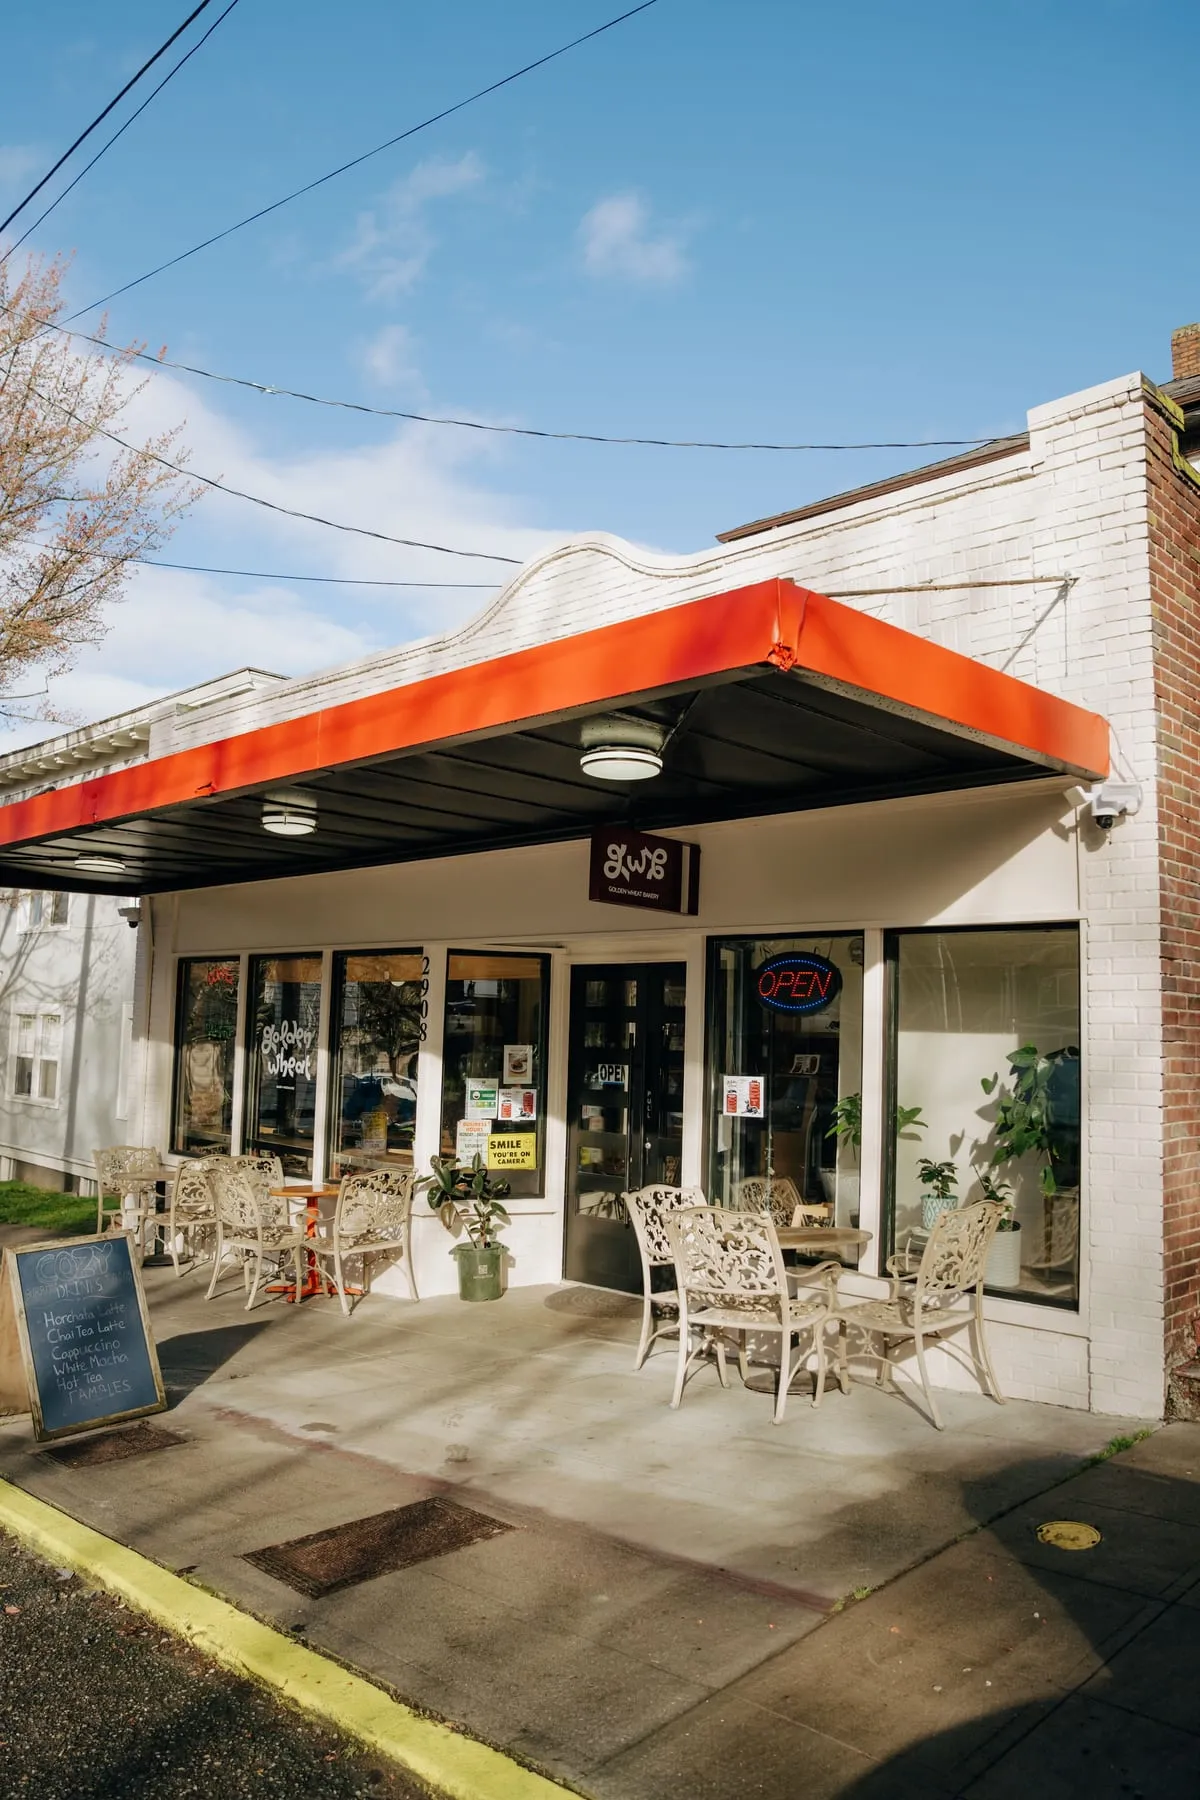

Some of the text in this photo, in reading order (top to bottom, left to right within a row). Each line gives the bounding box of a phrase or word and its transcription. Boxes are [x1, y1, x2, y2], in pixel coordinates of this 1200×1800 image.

[608, 886, 660, 900] GOLDEN WHEAT BAKERY
[758, 971, 832, 997] OPEN
[419, 956, 430, 1042] 2908
[261, 1020, 315, 1054] golden
[268, 1047, 311, 1081] wheat
[490, 1140, 521, 1149] SMILE
[36, 1243, 113, 1283] COZY
[43, 1307, 95, 1329] Horchata
[47, 1320, 126, 1344] Chai Tea Latte
[51, 1338, 120, 1361] Cappuccino
[53, 1350, 129, 1376] White Mocha
[56, 1371, 104, 1391] Hot Tea
